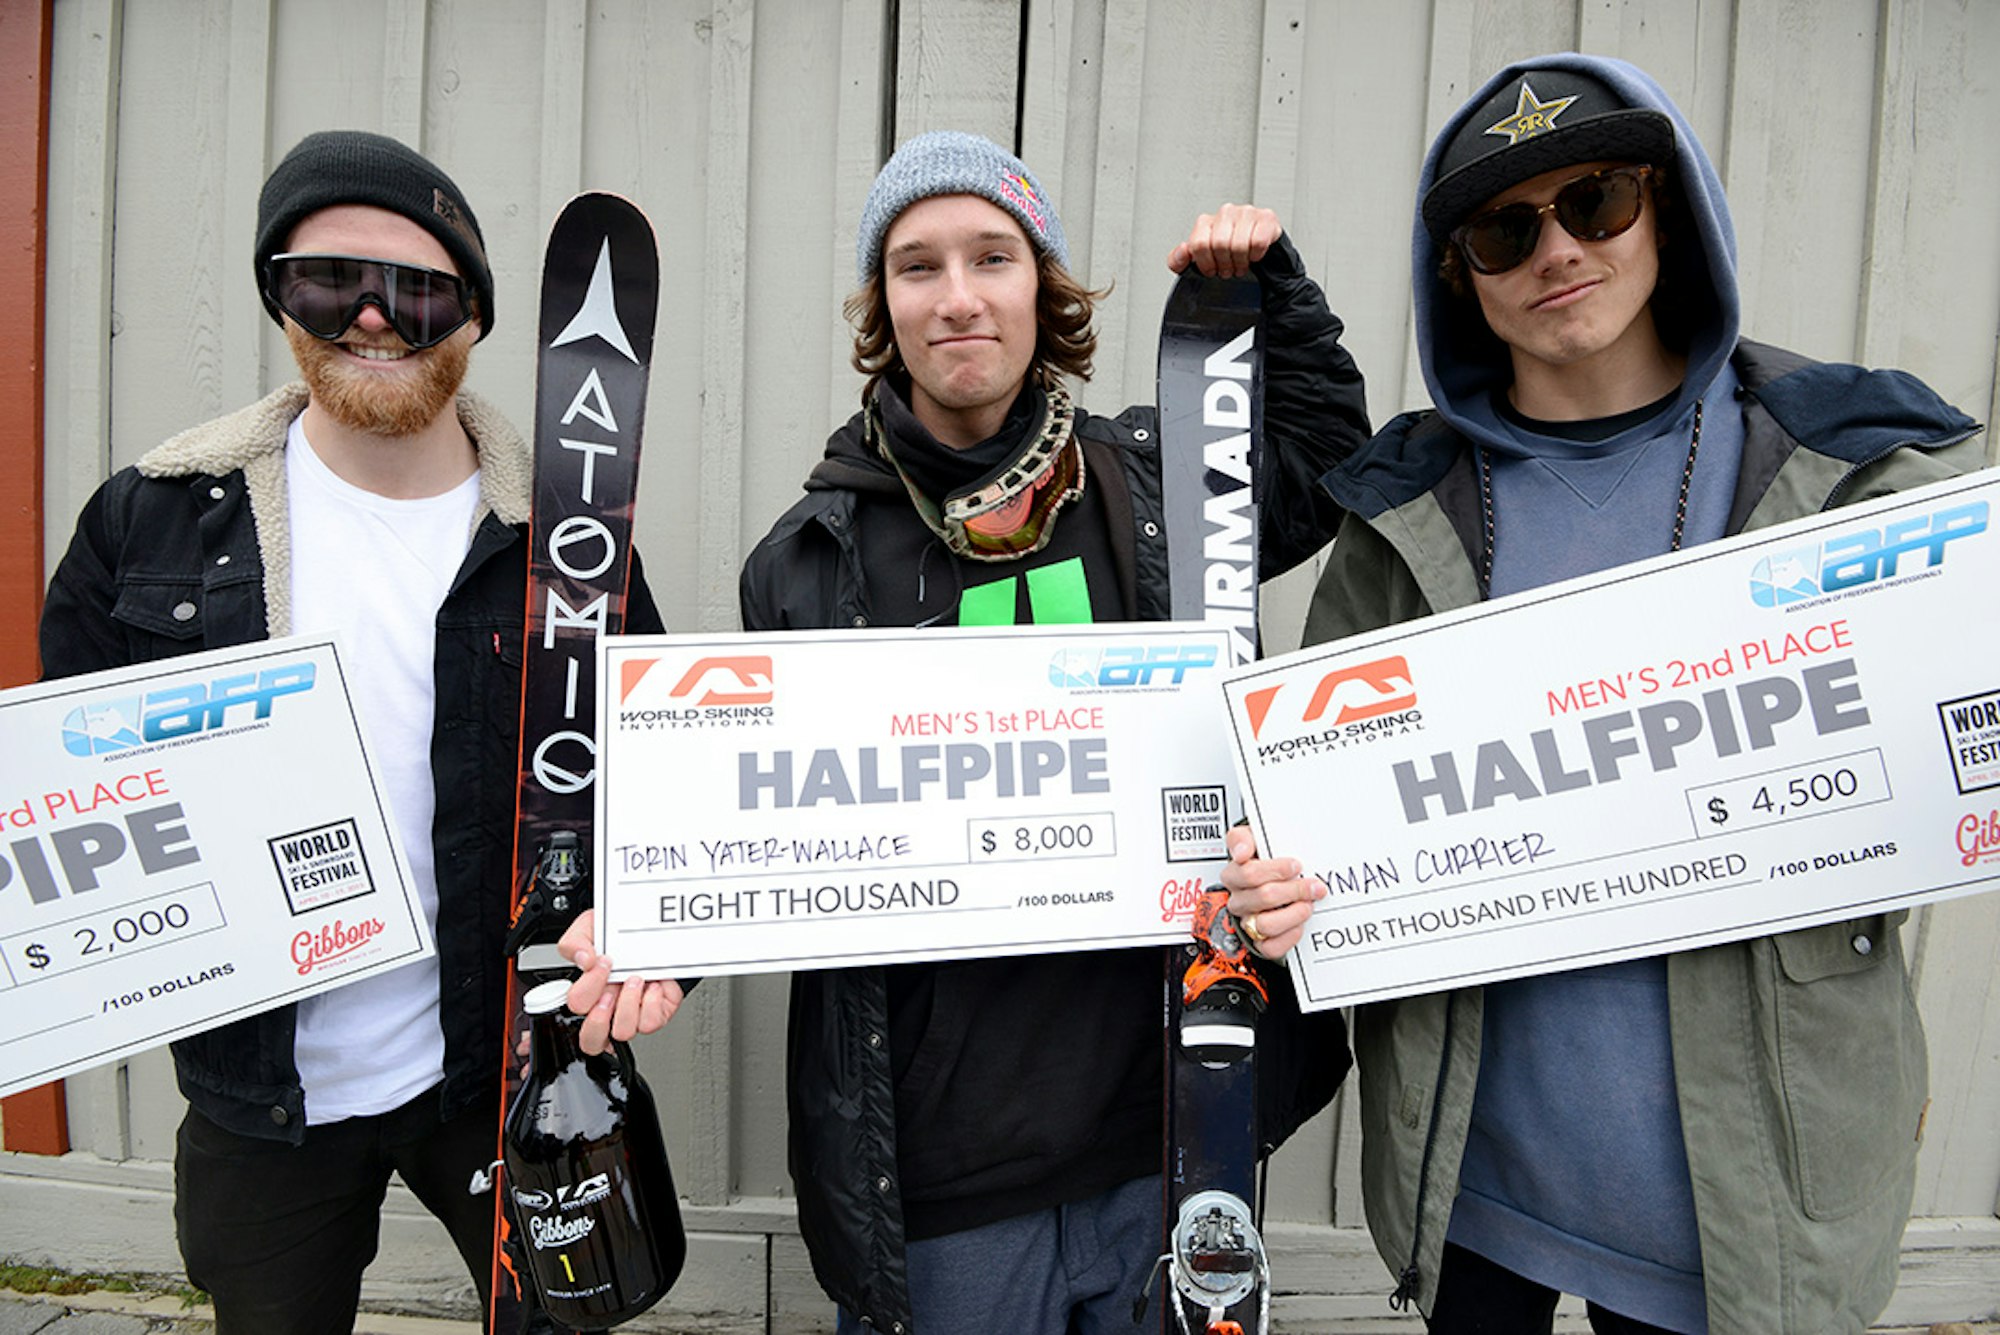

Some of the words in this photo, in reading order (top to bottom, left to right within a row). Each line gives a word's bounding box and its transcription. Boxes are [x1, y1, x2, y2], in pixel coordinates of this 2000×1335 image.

[532, 368, 619, 795] ATOMIC
[1666, 648, 1734, 688] 2nd
[1741, 619, 1853, 671] PLACE
[620, 708, 699, 723] WORLD
[704, 706, 774, 719] SKIING
[620, 718, 774, 731] INVITATIONAL
[986, 710, 1020, 733] 1st
[1026, 707, 1105, 731] PLACE
[1257, 729, 1341, 758] WORLD
[1345, 709, 1423, 738] SKIING
[1950, 700, 2000, 733] WOR
[1261, 724, 1425, 766] INVITATIONAL
[1392, 658, 1871, 824] HALFPIPE
[1960, 741, 2000, 767] FEST
[43, 768, 171, 820] PLACE
[738, 738, 1111, 811] HALFPIPE
[1169, 793, 1220, 814] WORLD
[1707, 797, 1729, 826] $
[1751, 768, 1858, 816] 4,500
[0, 802, 202, 905] IPE
[280, 829, 350, 864] WORLD
[981, 829, 997, 855] $
[1015, 824, 1094, 854] 8,000
[1171, 824, 1222, 841] FESTIVAL
[614, 844, 688, 874] TORIN
[700, 834, 913, 874] YATER-WALLACE
[1300, 857, 1400, 895] YMAN
[1414, 832, 1556, 883] CURRIER
[1769, 859, 1808, 881] /100
[1813, 841, 1898, 871] DOLLARS
[291, 861, 360, 892] FESTIVAL
[659, 890, 761, 923] EIGHT
[769, 879, 960, 916] THOUSAND
[1018, 894, 1048, 908] /100
[1052, 890, 1115, 906] DOLLARS
[1160, 878, 1202, 923] Gibb
[1311, 923, 1380, 952] FOUR
[1383, 894, 1536, 939] THOUSAND
[1541, 881, 1599, 911] FIVE
[1603, 853, 1747, 900] HUNDRED
[24, 941, 52, 971] $
[74, 902, 190, 956] 2,000
[290, 918, 386, 976] Gibbons
[101, 990, 145, 1014] /100
[149, 962, 236, 997] DOLLARS
[529, 1214, 596, 1250] Gibbons
[558, 1253, 575, 1282] 1
